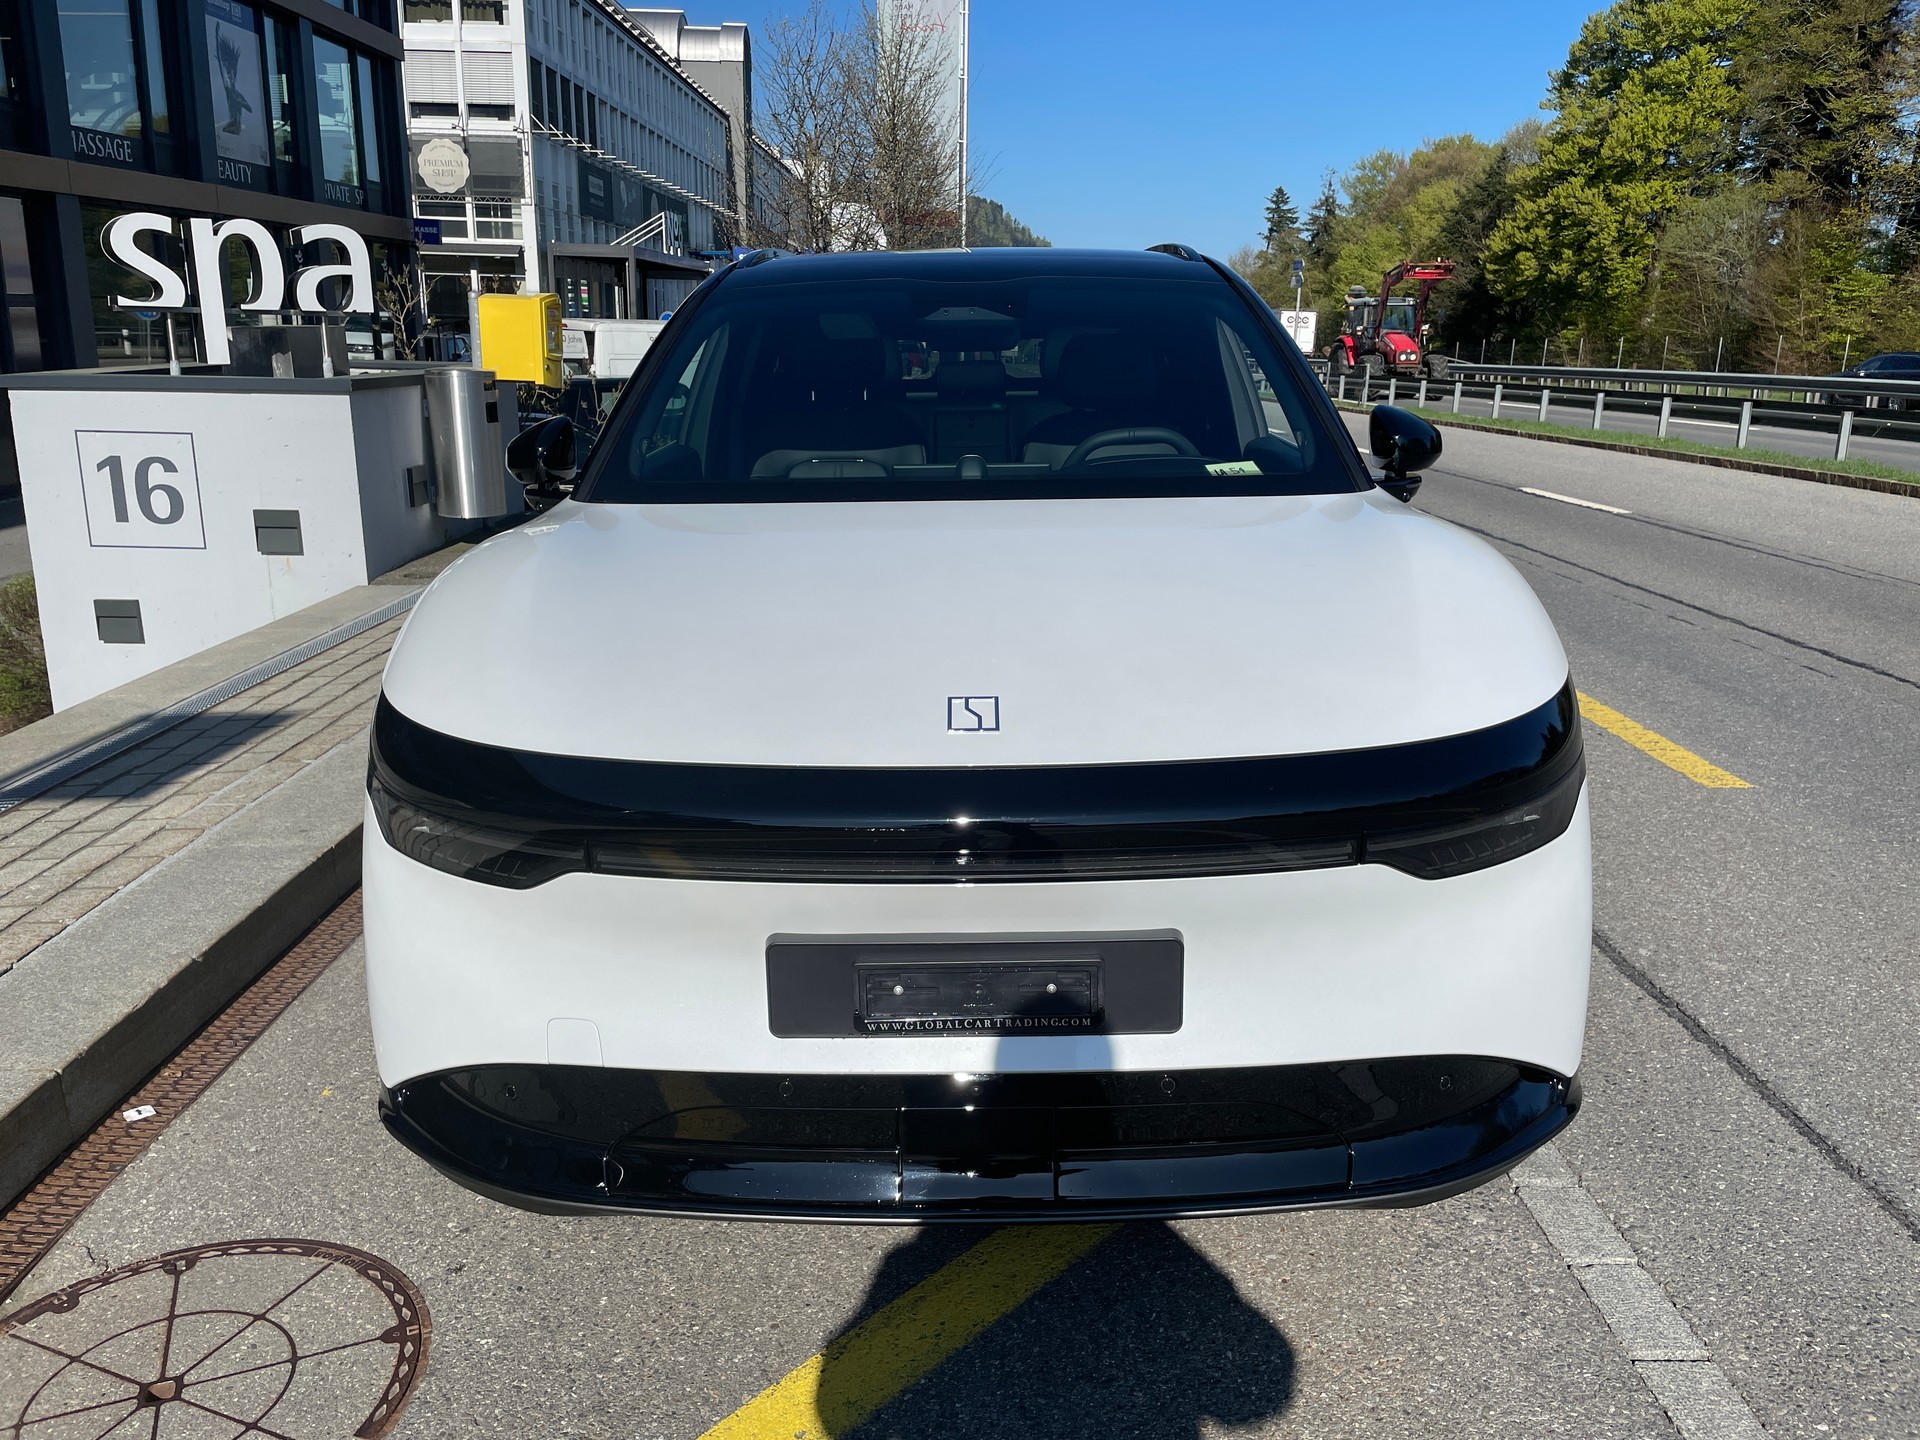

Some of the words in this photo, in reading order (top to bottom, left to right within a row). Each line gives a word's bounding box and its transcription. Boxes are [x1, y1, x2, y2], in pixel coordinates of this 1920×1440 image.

[423, 159, 464, 168] PREMIUM
[432, 169, 457, 177] SHOP
[414, 226, 438, 234] KASSE
[100, 212, 374, 365] spa
[567, 334, 583, 344] Jahre
[96, 454, 185, 525] 16
